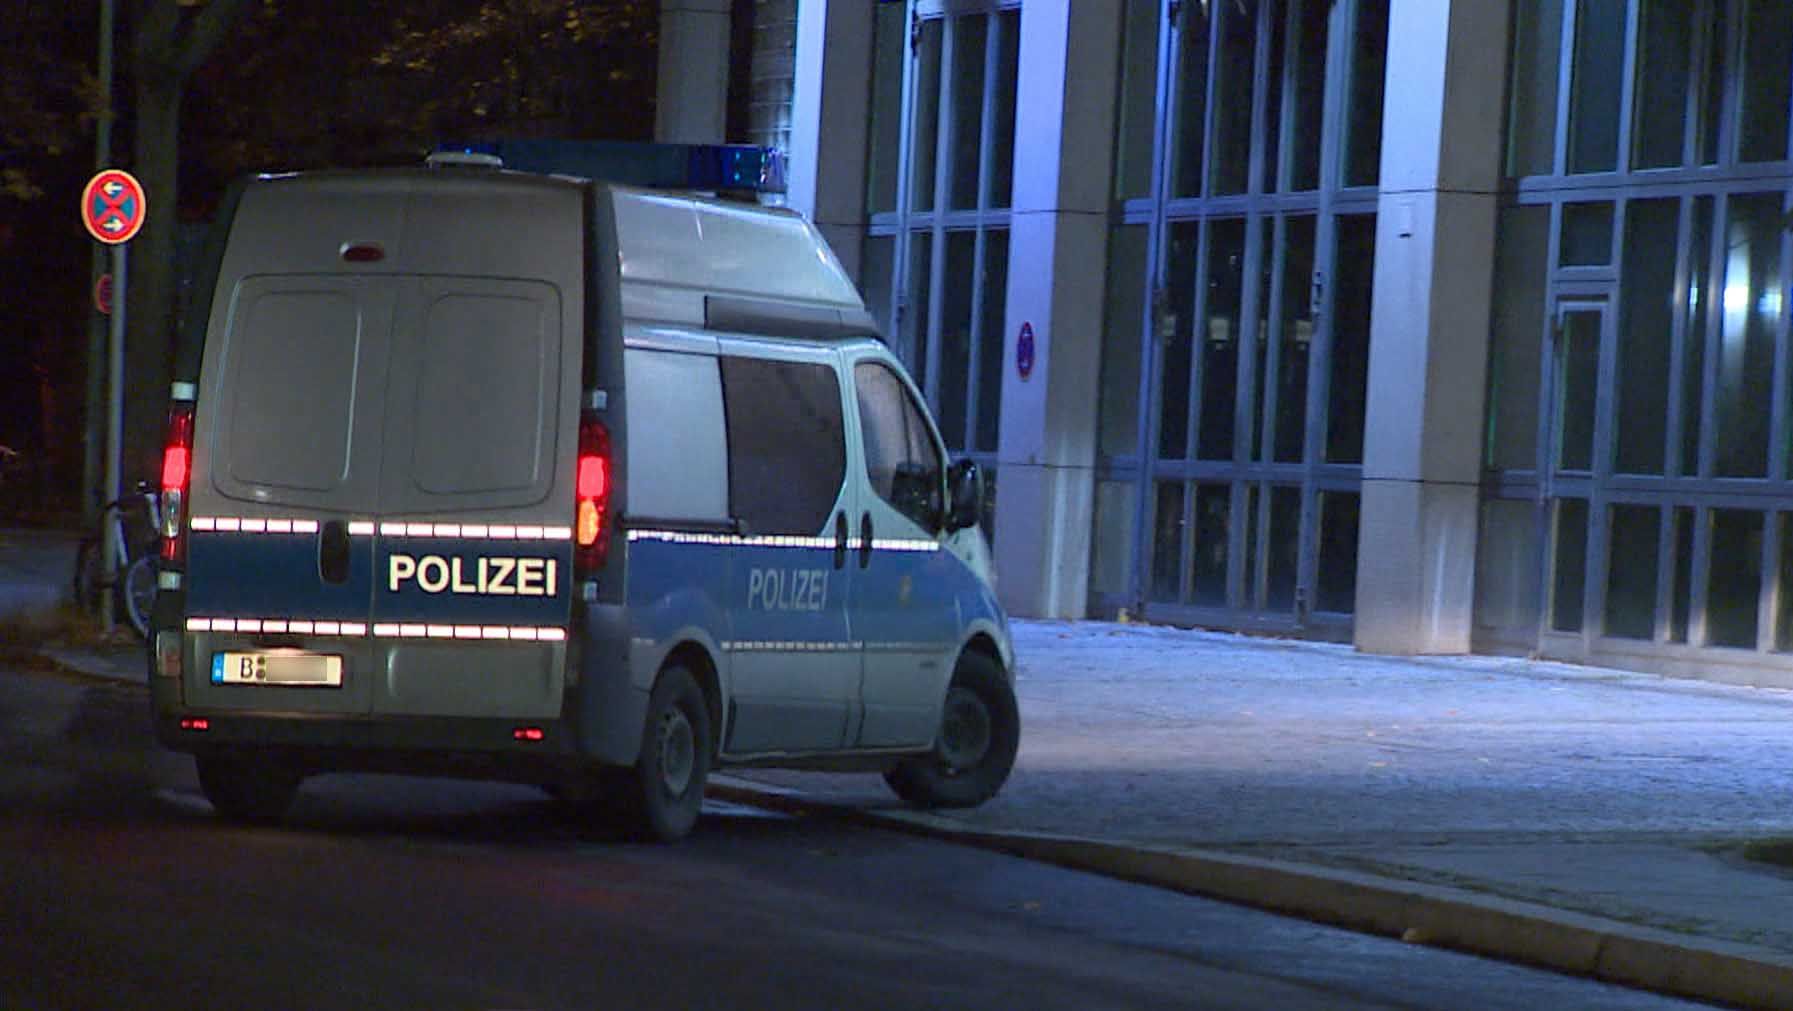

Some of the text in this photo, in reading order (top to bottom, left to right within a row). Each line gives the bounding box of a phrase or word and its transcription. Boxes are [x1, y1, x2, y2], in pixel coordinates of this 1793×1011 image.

[389, 554, 557, 596] POLIZEI
[747, 568, 829, 611] POLIZEI
[240, 656, 254, 679] B
